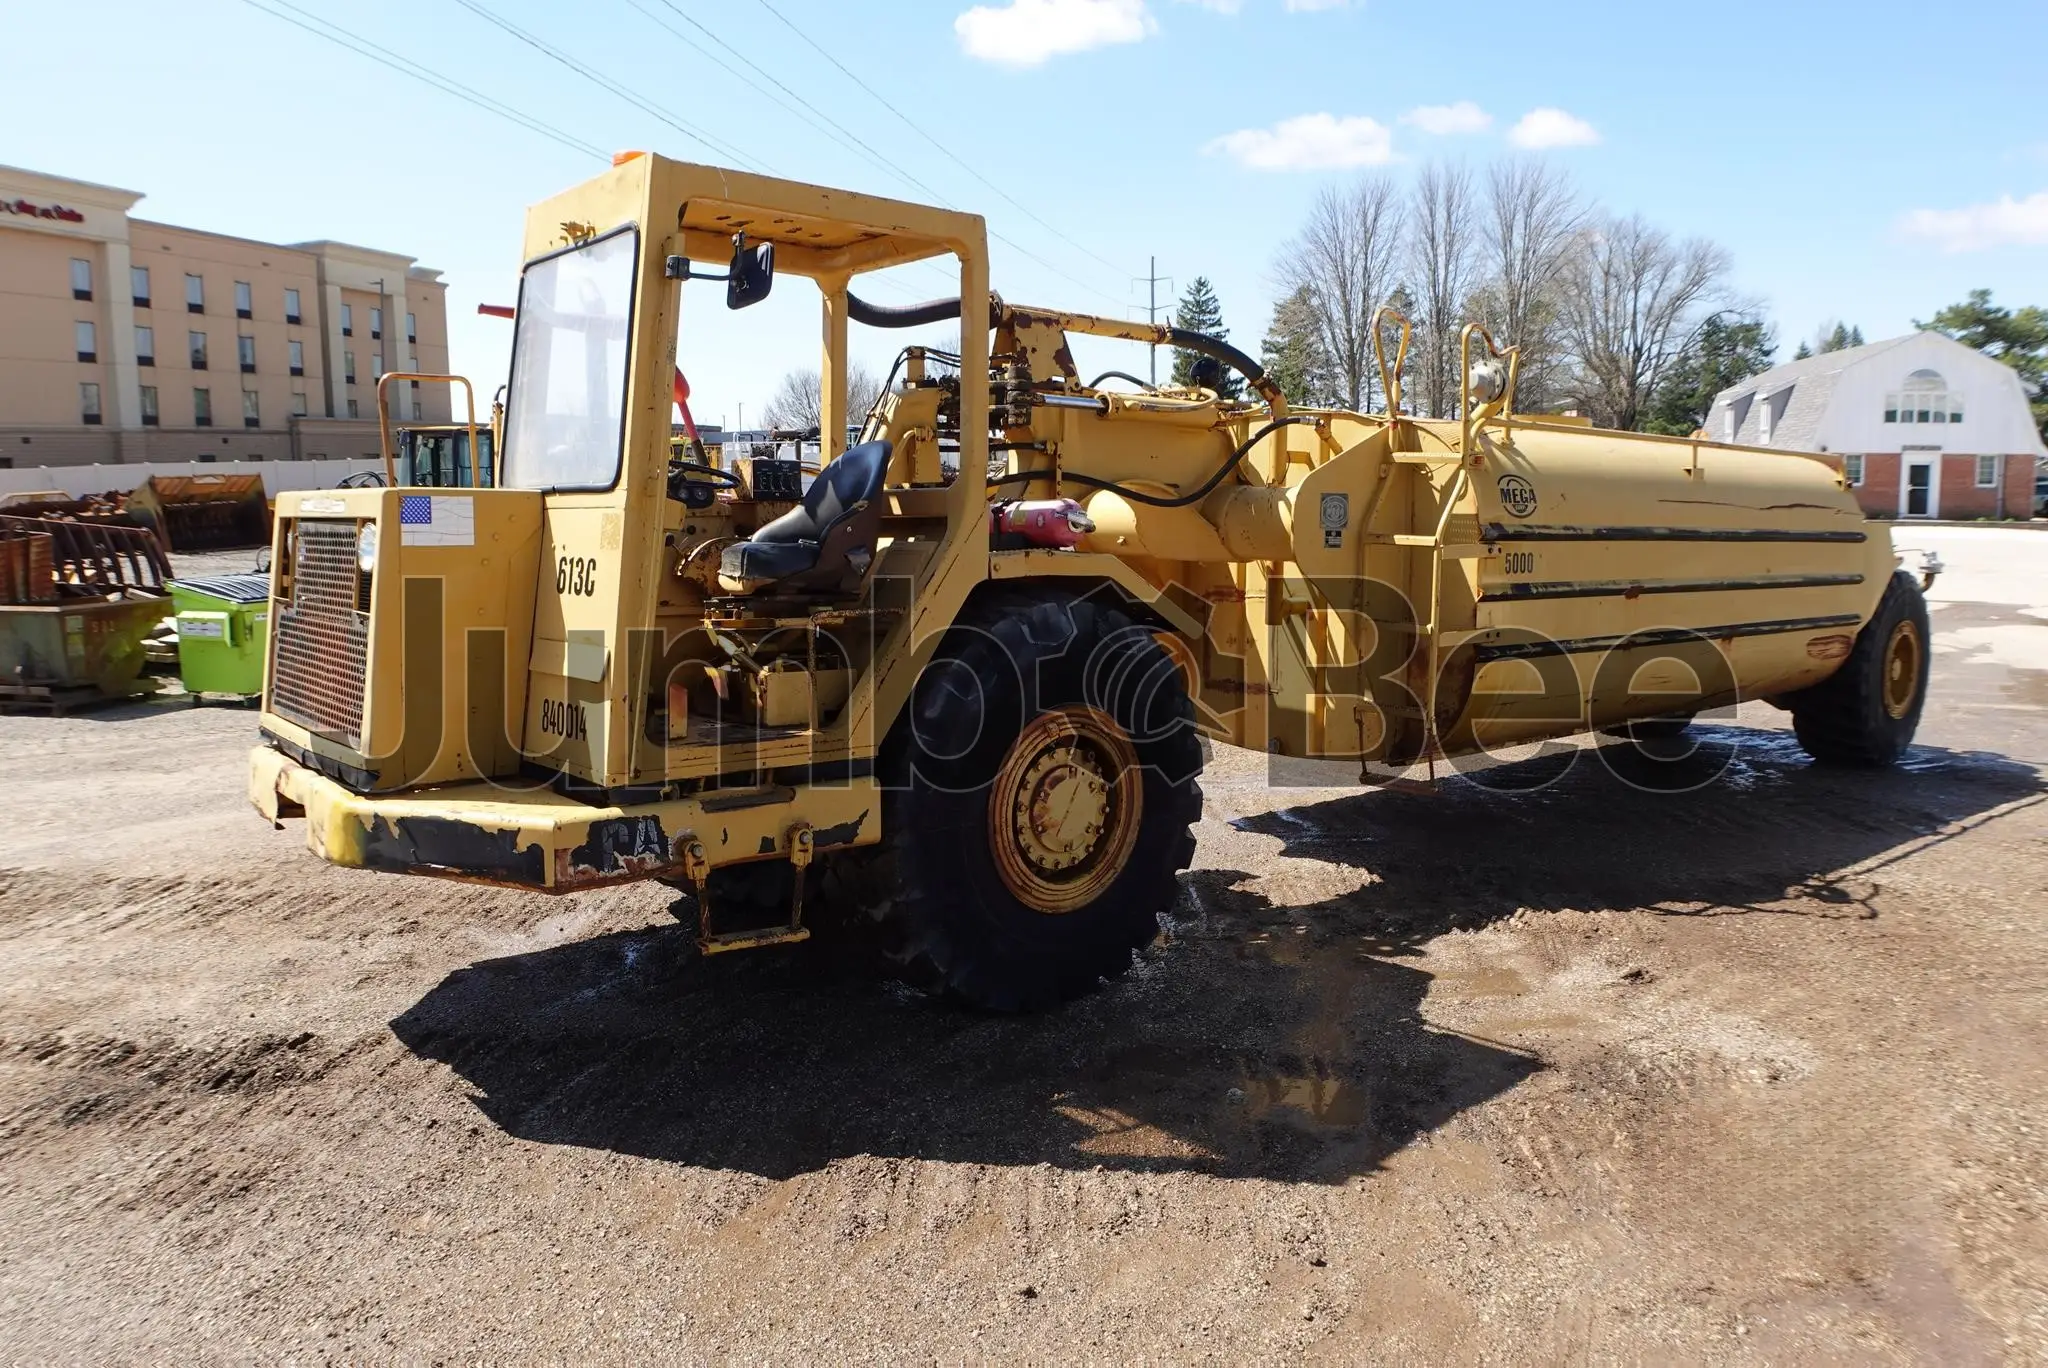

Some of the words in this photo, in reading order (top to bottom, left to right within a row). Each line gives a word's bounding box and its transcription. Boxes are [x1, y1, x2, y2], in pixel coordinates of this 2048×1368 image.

[1500, 487, 1537, 504] MEGA
[557, 556, 597, 597] 613C
[1505, 552, 1534, 574] 5000
[542, 698, 587, 742] 840014
